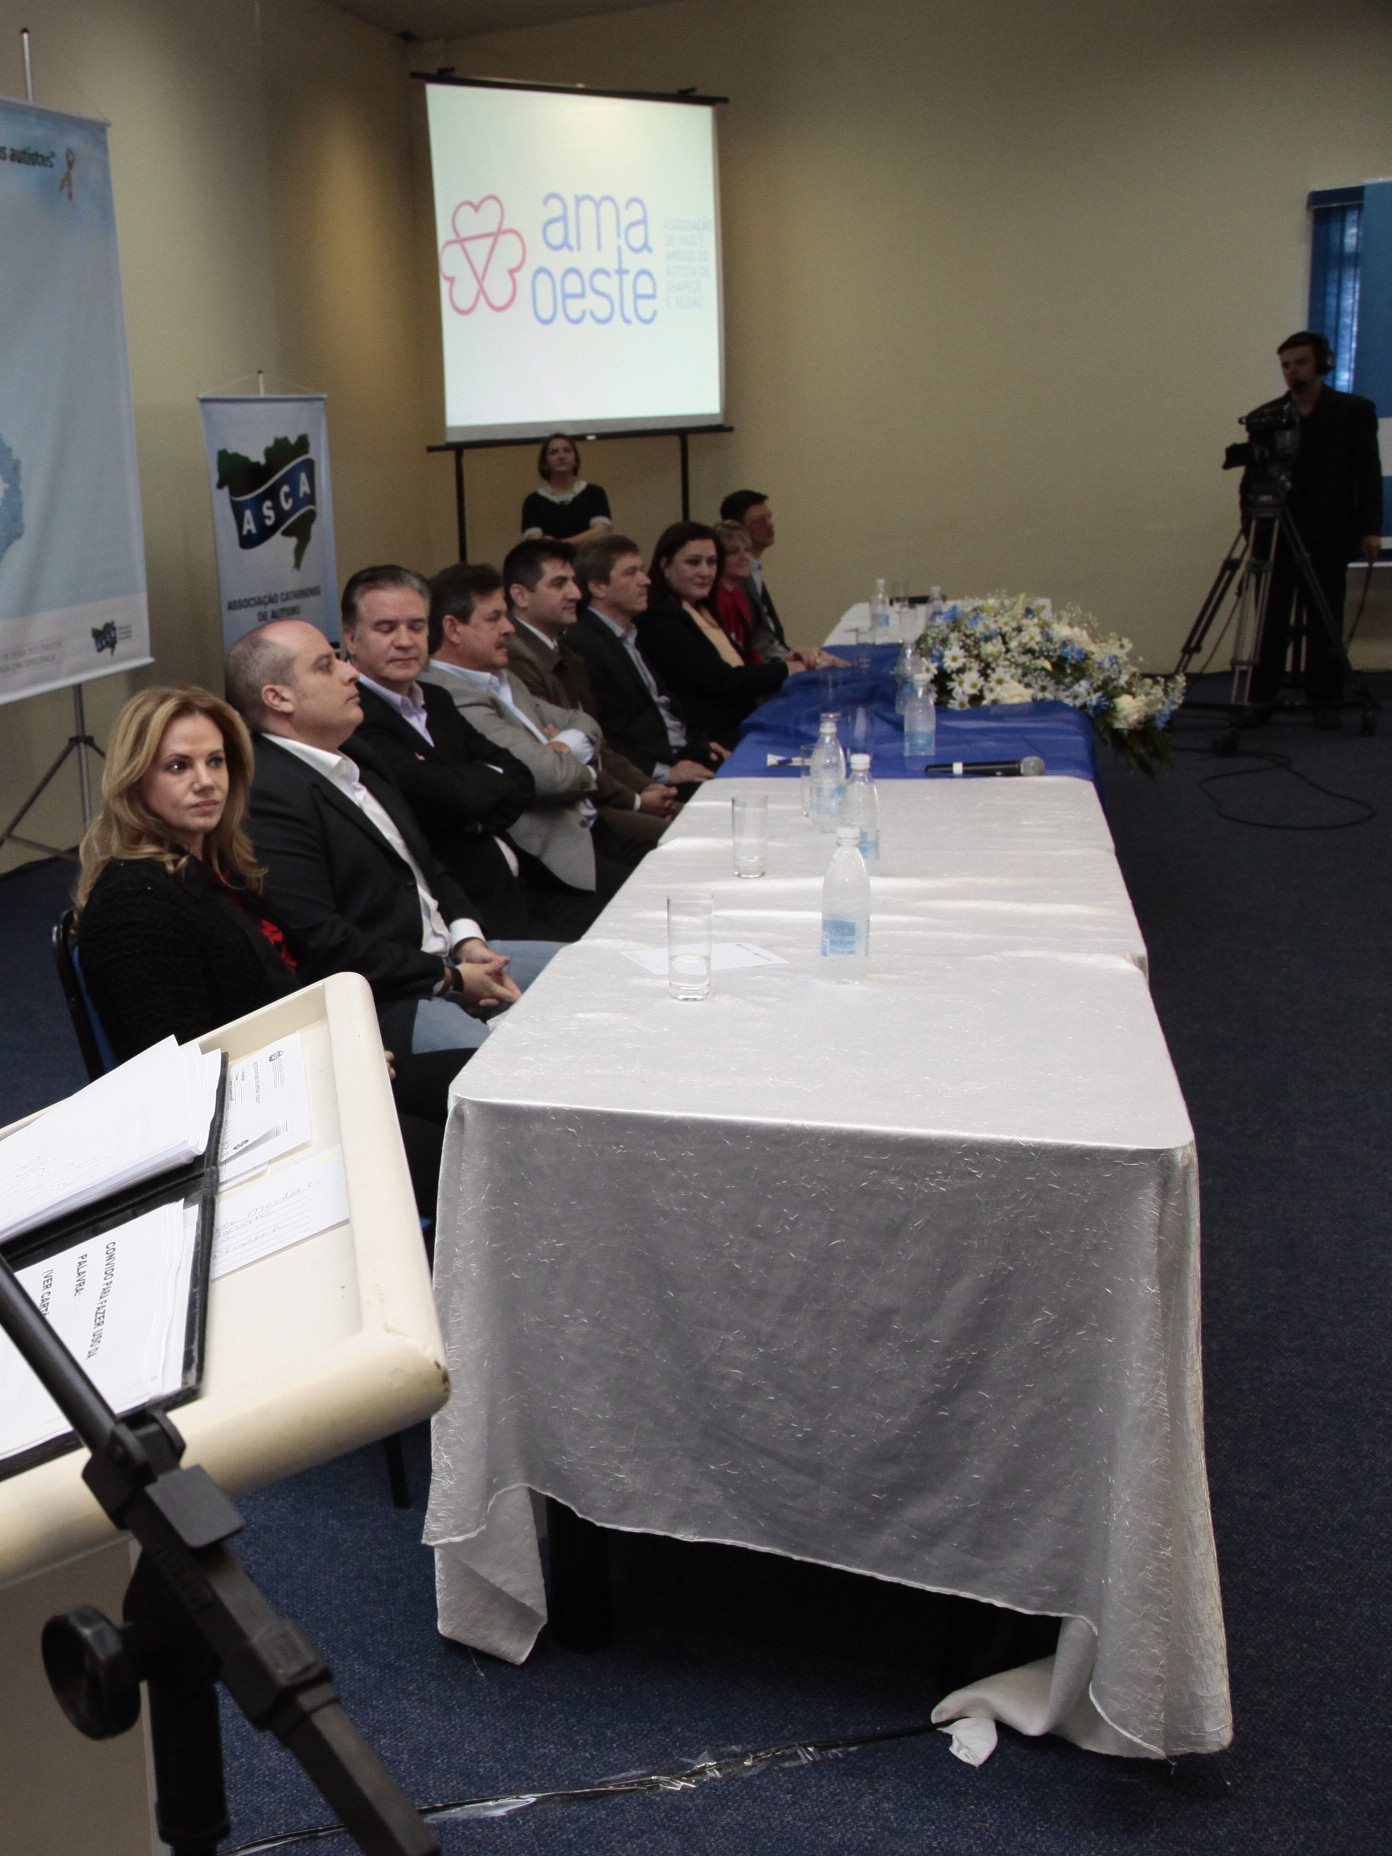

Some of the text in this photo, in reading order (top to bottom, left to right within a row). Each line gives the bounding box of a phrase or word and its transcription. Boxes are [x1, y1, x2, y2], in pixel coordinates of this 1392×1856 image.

[542, 192, 654, 254] ama
[531, 244, 658, 326] oeste
[242, 472, 311, 536] ASCA
[227, 591, 279, 612] ASSOCIAÇÃO
[257, 610, 269, 622] DE
[104, 1241, 116, 1281] CONVIDO
[41, 1269, 54, 1292] (VER
[98, 1280, 113, 1301] PARA
[93, 1299, 108, 1330] FAZER
[89, 1328, 104, 1348] USO
